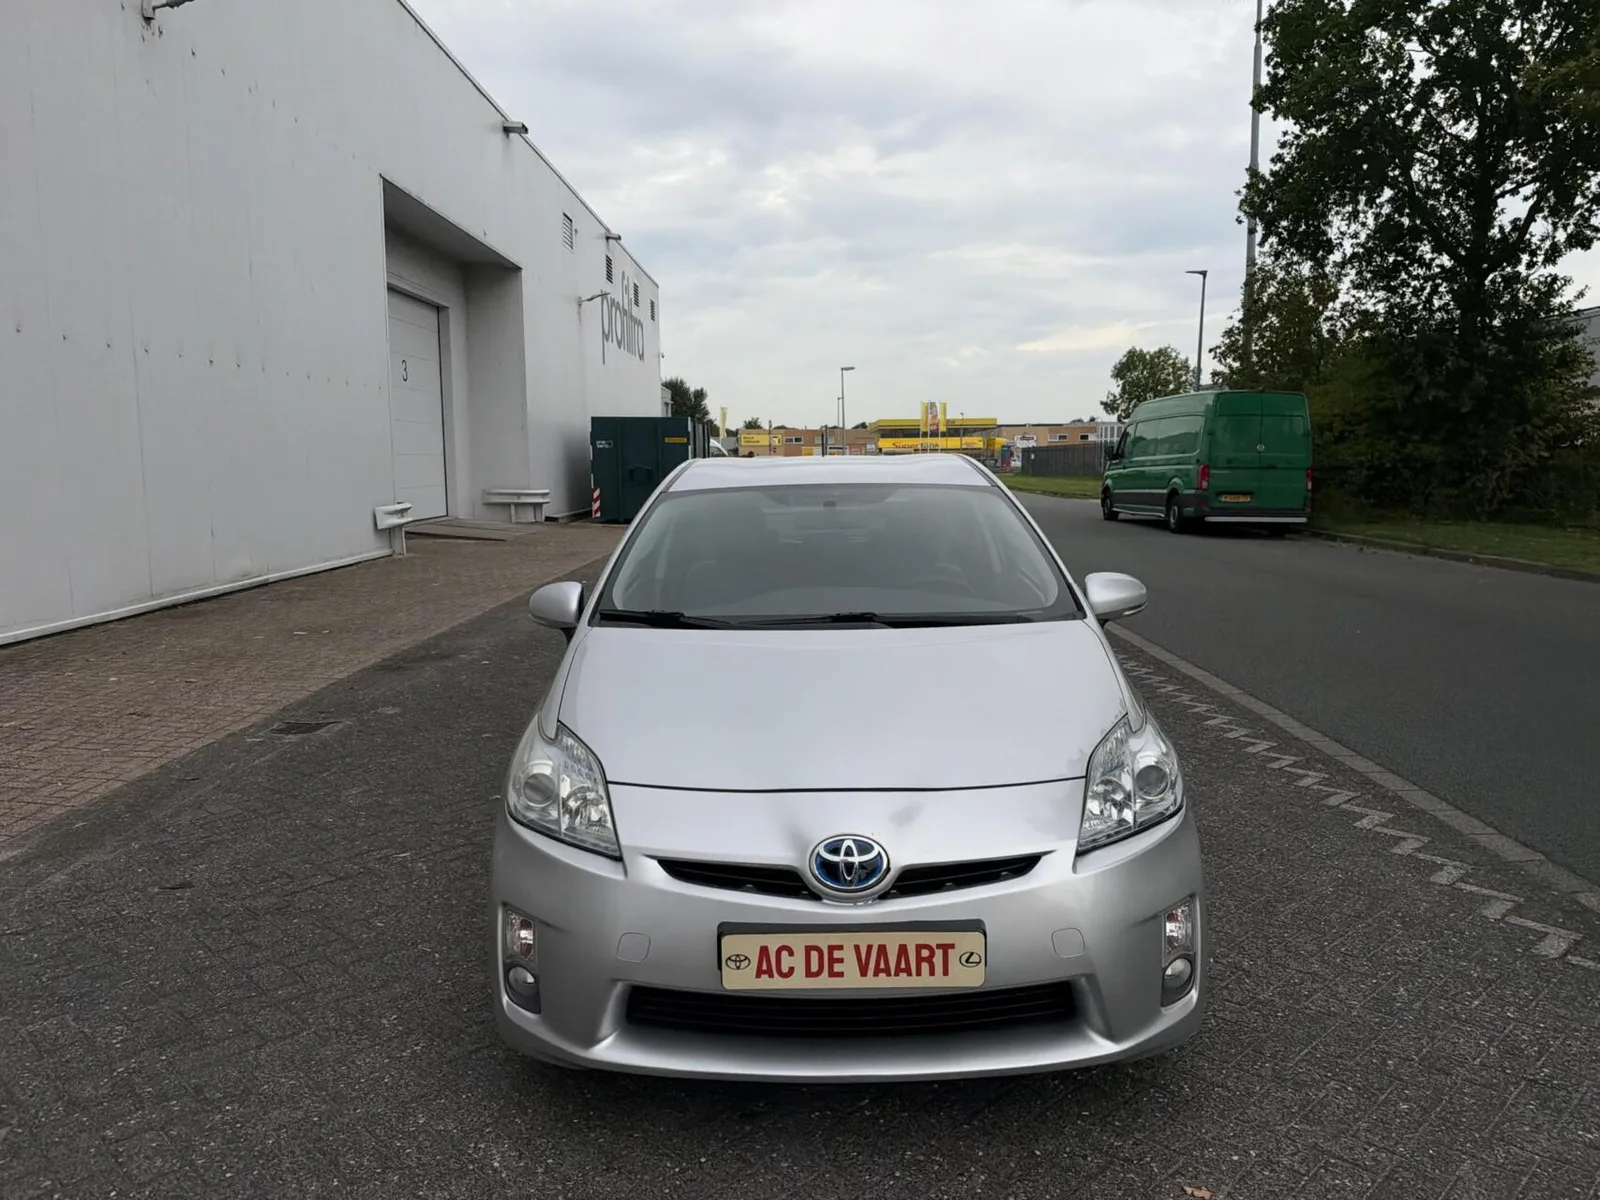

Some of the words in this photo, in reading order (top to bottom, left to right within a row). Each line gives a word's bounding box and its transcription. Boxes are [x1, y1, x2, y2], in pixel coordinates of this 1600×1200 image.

[600, 270, 645, 365] profiltra
[401, 359, 408, 382] 3
[755, 944, 795, 979] AC
[804, 944, 844, 978] DE
[853, 943, 955, 977] VAART
